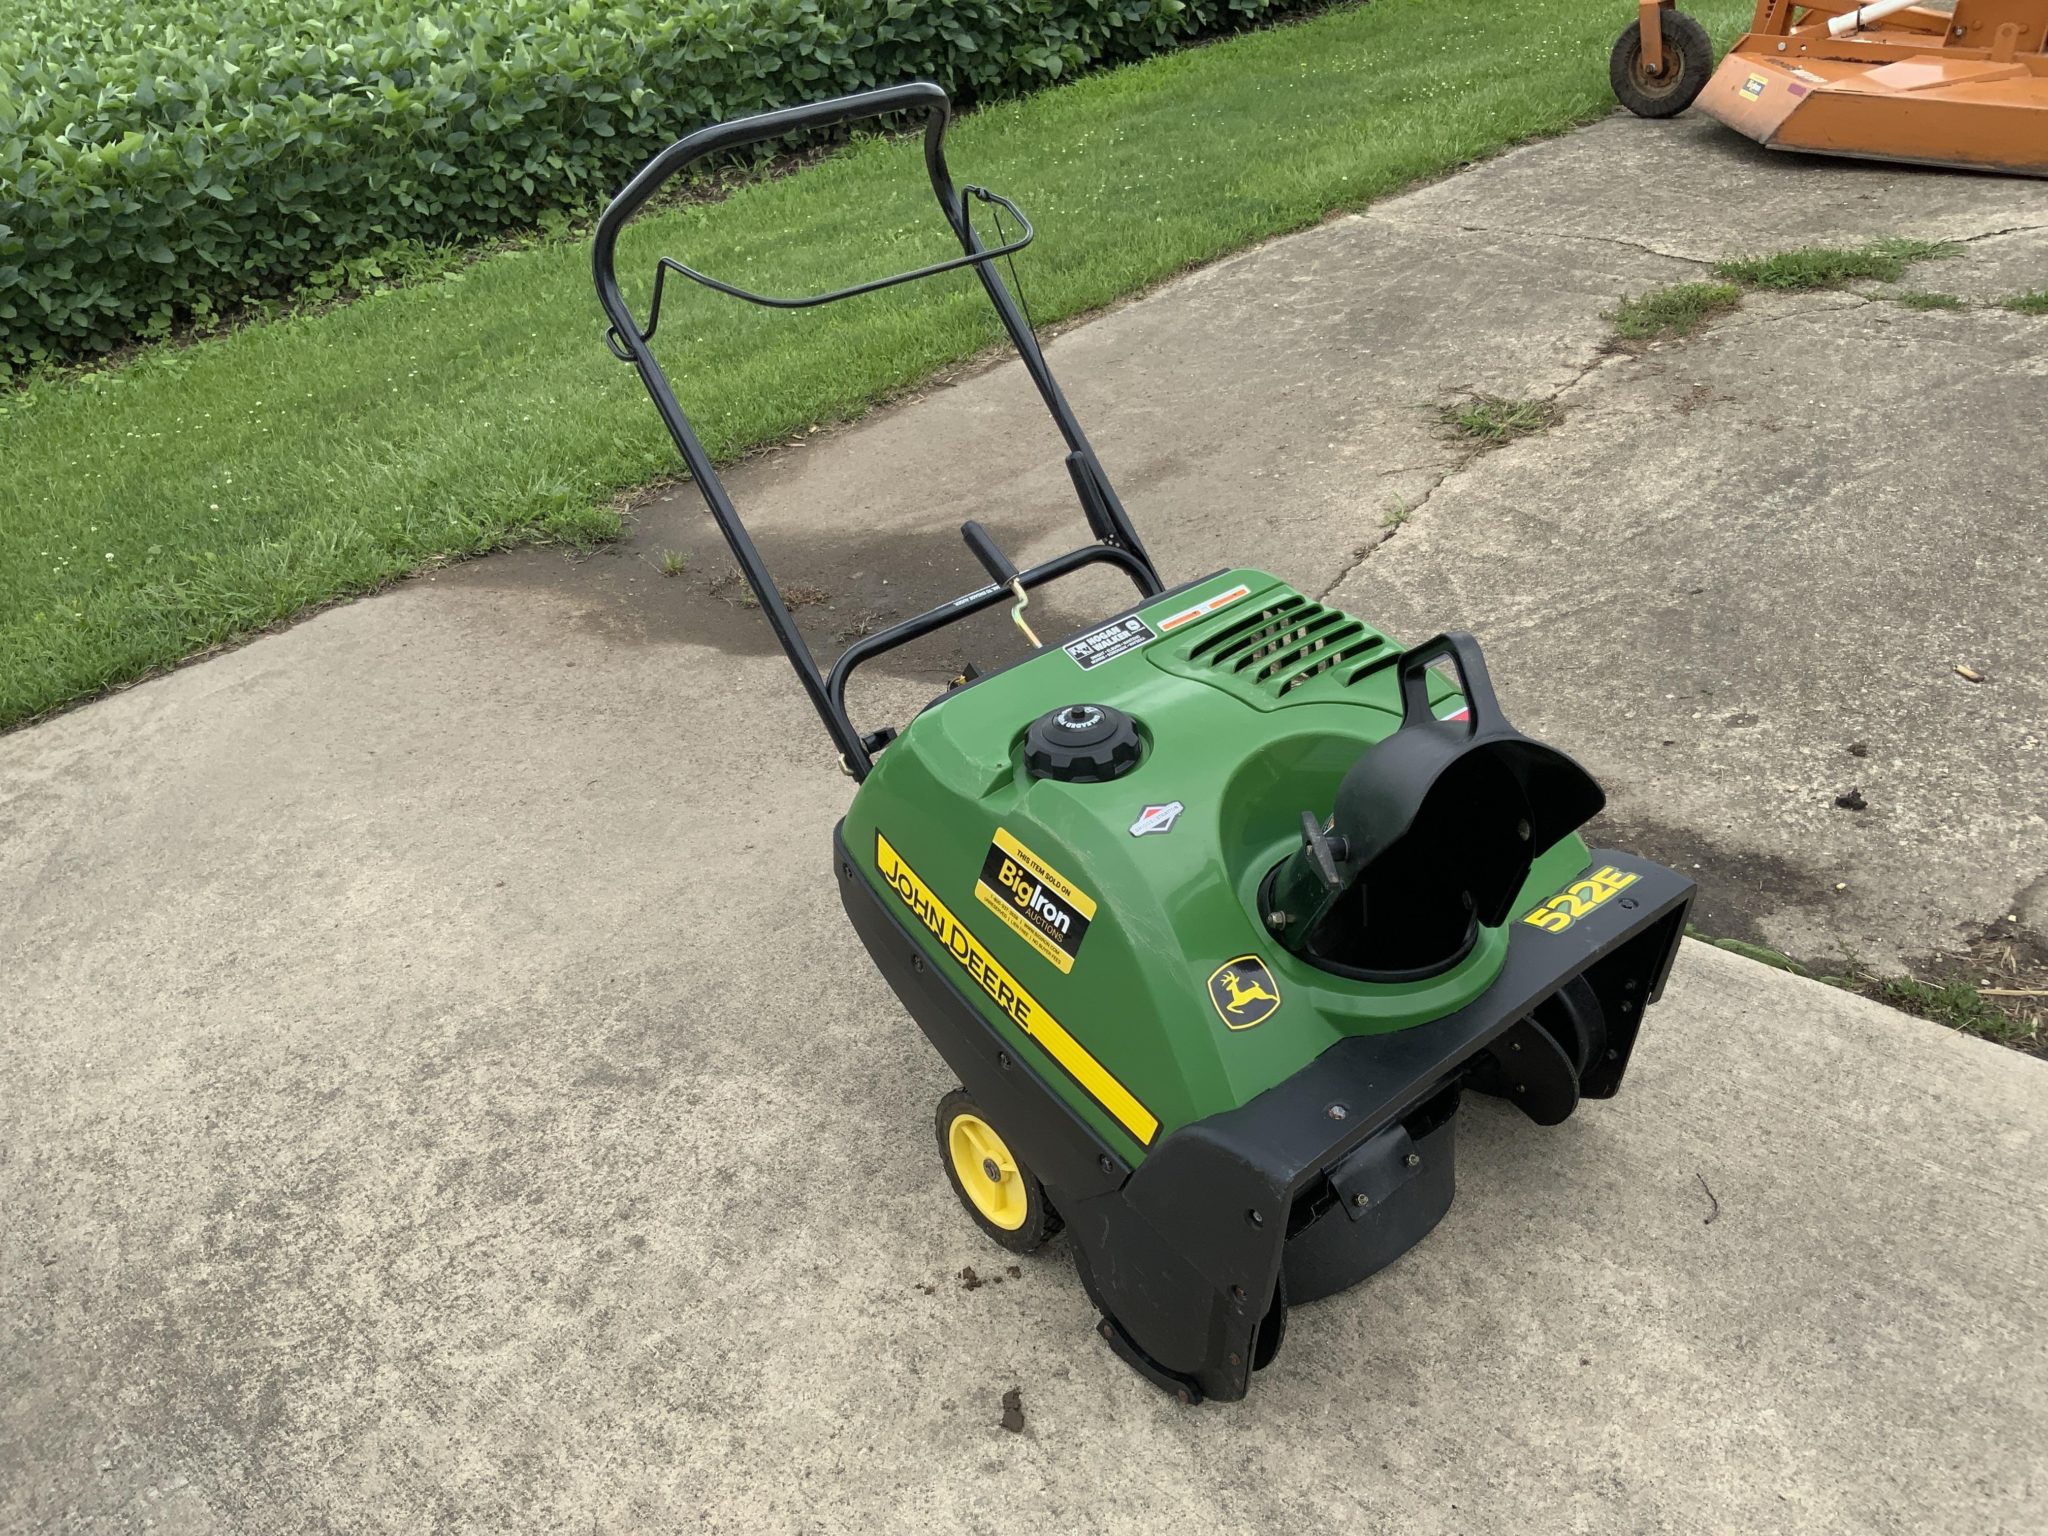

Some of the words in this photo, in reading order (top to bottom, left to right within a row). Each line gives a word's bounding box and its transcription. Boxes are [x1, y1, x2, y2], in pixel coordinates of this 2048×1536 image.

[1086, 626, 1121, 645] HOGAN
[1092, 630, 1132, 651] WALKER
[998, 858, 1071, 934] BigIron
[1016, 849, 1030, 864] THIS
[1030, 861, 1046, 876] ITEM
[1045, 872, 1061, 888] SOLD
[1060, 885, 1071, 897] ON
[1523, 866, 1638, 932] 522E
[885, 861, 946, 940] JOHN
[950, 924, 1031, 1029] DEERE
[1025, 908, 1064, 943] AUCTIONS
